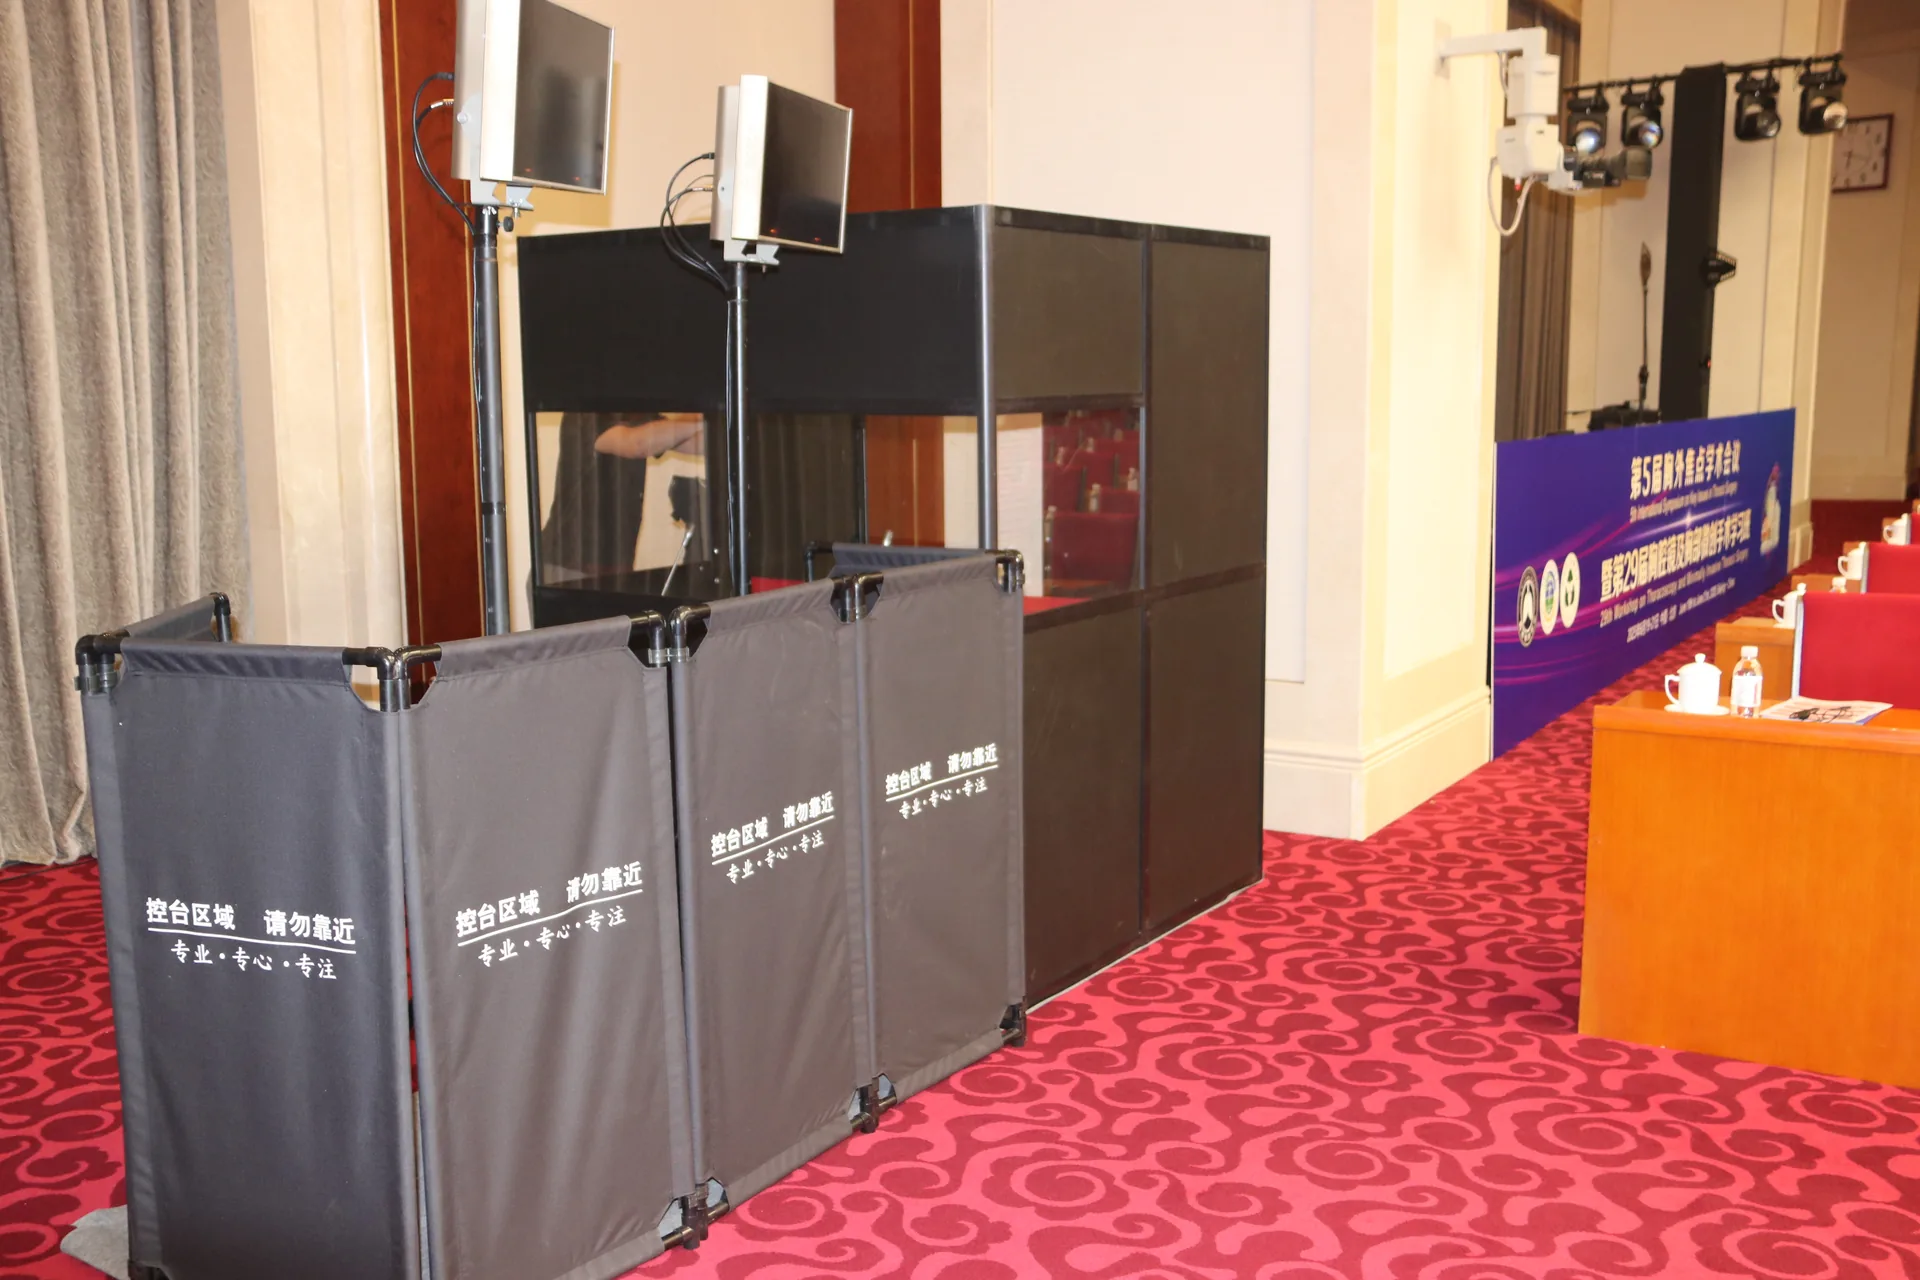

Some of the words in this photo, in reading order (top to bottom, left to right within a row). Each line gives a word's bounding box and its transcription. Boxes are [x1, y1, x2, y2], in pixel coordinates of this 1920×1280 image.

[1630, 439, 1741, 500] 第5届胸外焦点学术会议
[886, 761, 933, 795] 控台区域
[947, 743, 998, 774] 请勿靠近
[711, 817, 768, 857] 控台区域
[783, 791, 835, 828] 请勿靠近
[146, 897, 236, 930] 控台区域
[263, 909, 355, 944] 请勿靠近
[456, 890, 541, 937] 控台区域
[566, 861, 643, 903] 请勿靠近
